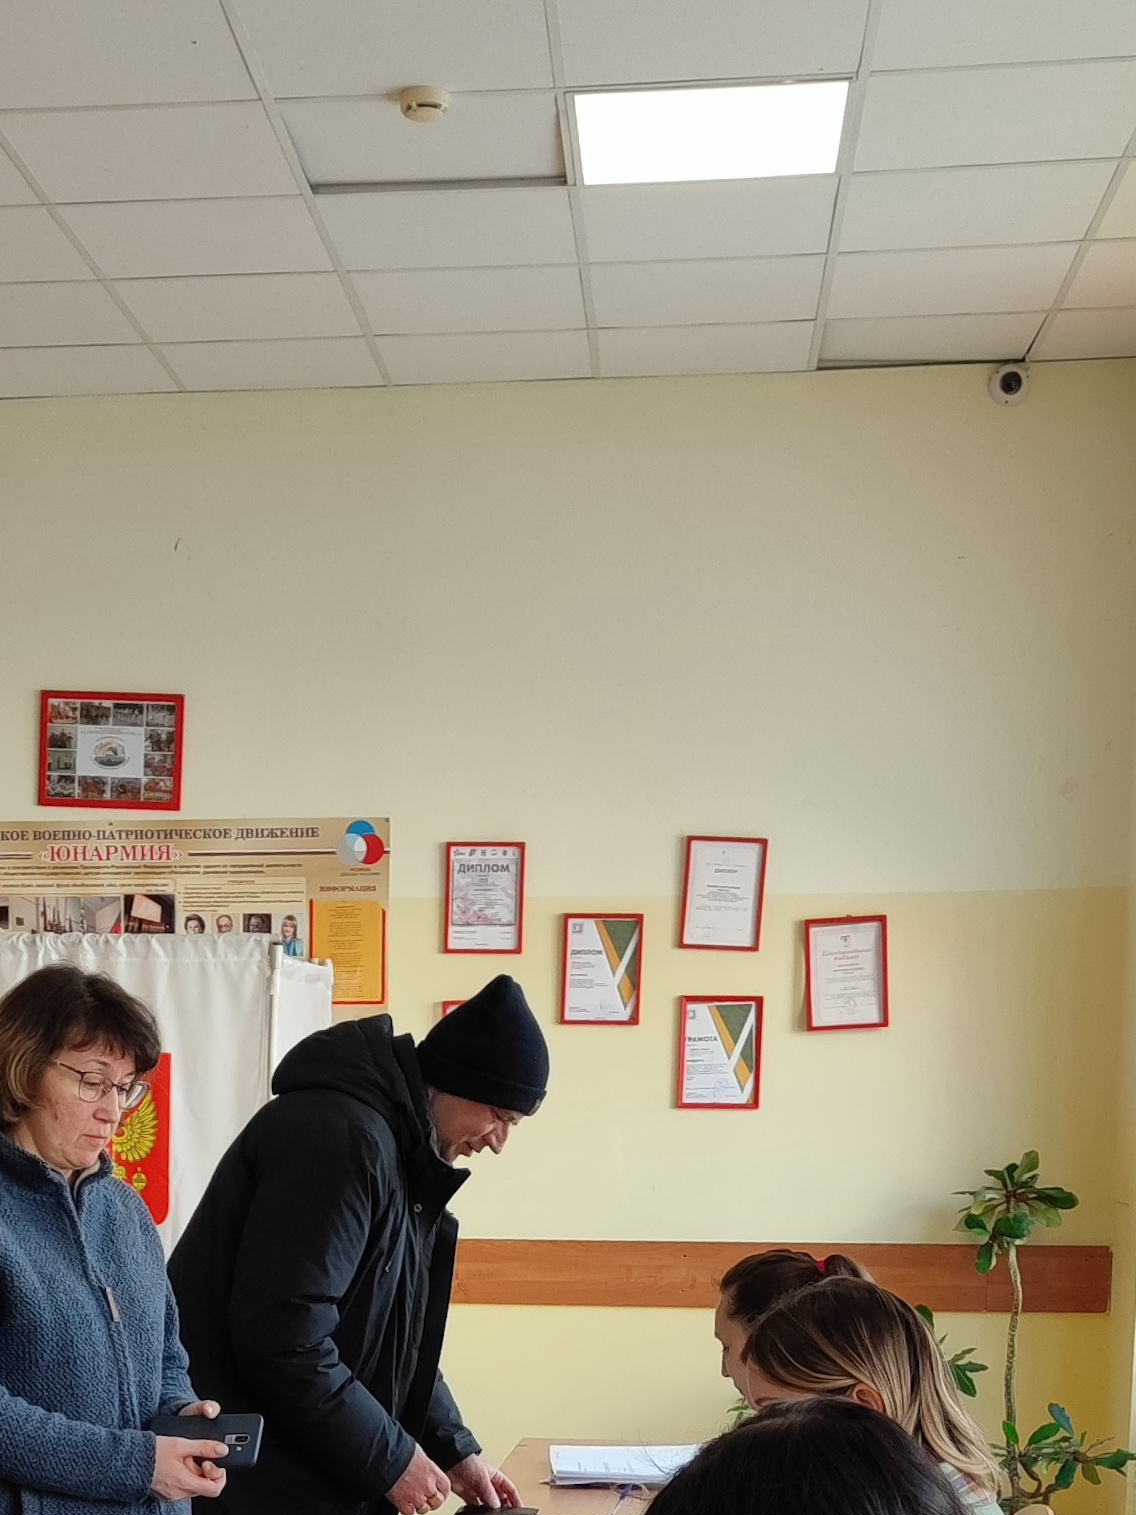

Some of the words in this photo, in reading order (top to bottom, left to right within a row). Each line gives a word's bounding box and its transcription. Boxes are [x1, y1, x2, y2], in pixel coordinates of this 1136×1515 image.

[32, 827, 232, 841] ВОЕННО-ПАТРИОТИЧЕСКОЕ
[235, 826, 320, 841] ДВИЖЕНИЕ
[457, 863, 510, 874] ДИПЛОМ
